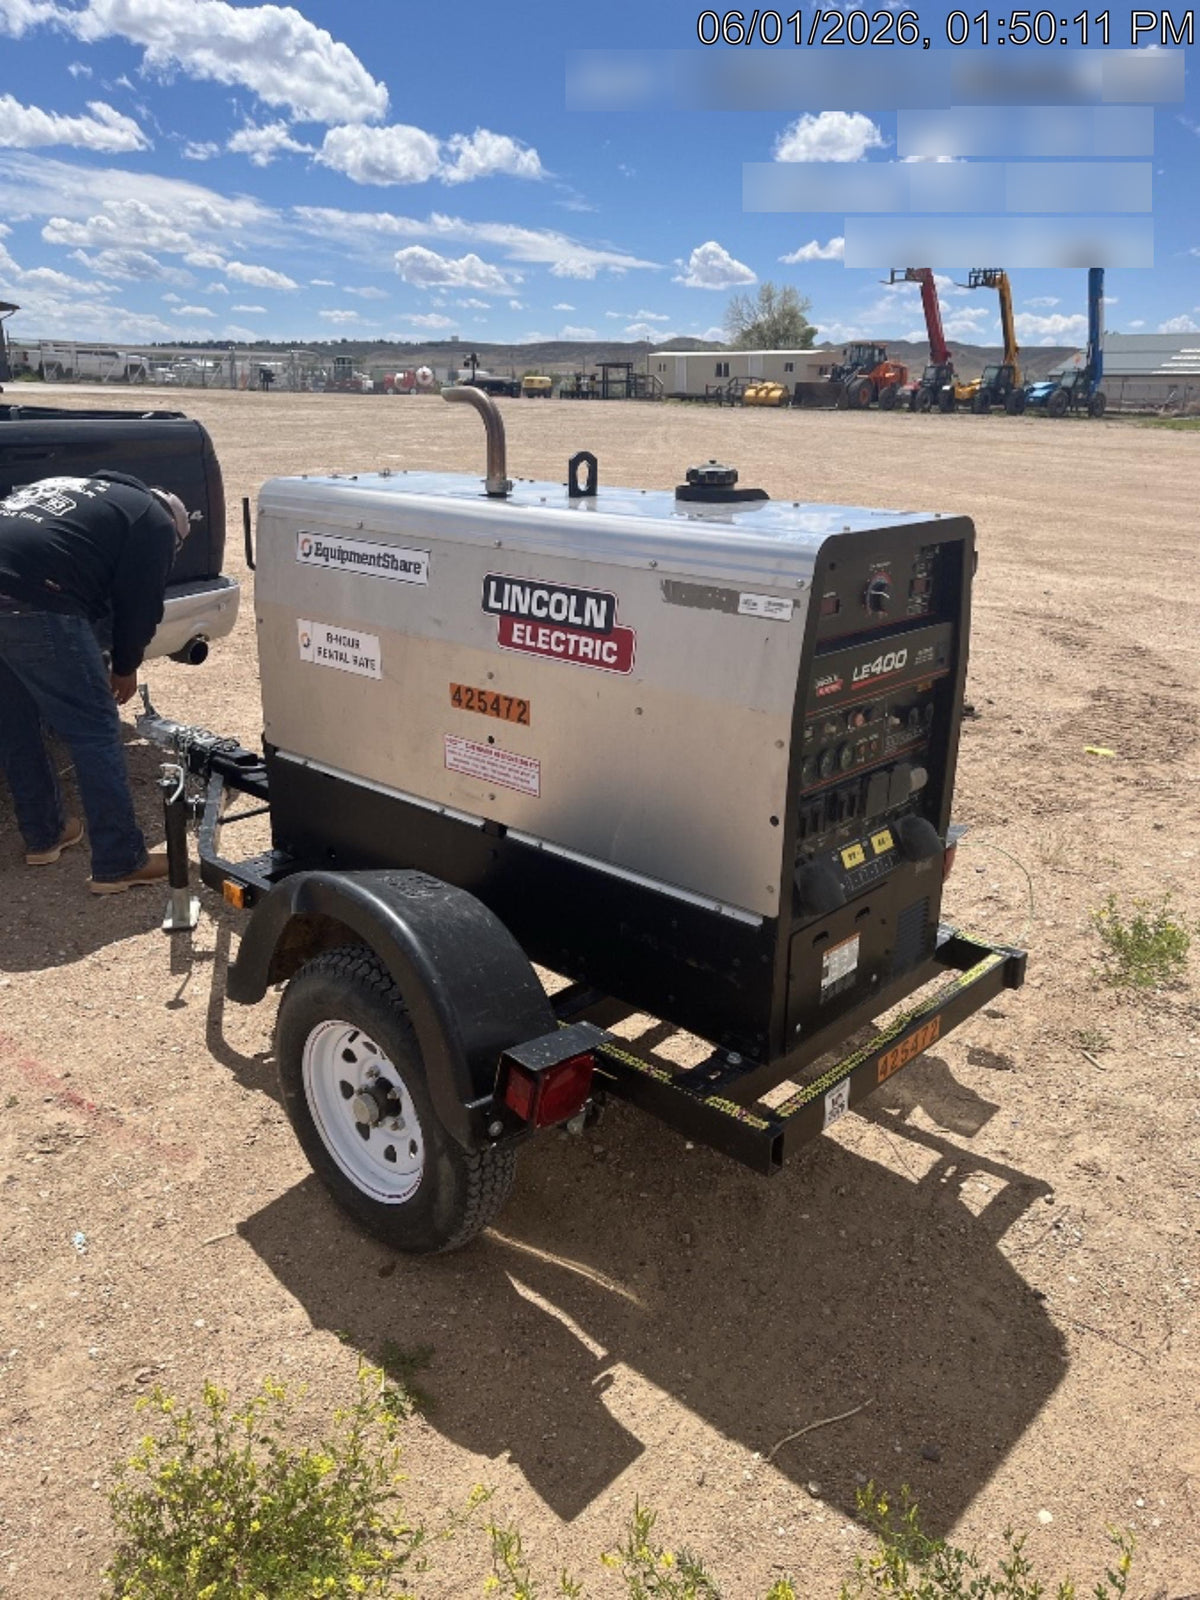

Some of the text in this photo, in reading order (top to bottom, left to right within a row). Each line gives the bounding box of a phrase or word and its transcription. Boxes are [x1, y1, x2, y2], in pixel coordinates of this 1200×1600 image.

[314, 541, 422, 575] EquipmentShare
[488, 581, 607, 629] LINCOLN
[317, 647, 376, 671] RENTAL RATE
[511, 622, 618, 664] ELECTRIC
[852, 648, 908, 681] LE400
[453, 685, 527, 725] 425472
[880, 1018, 938, 1077] 425472
